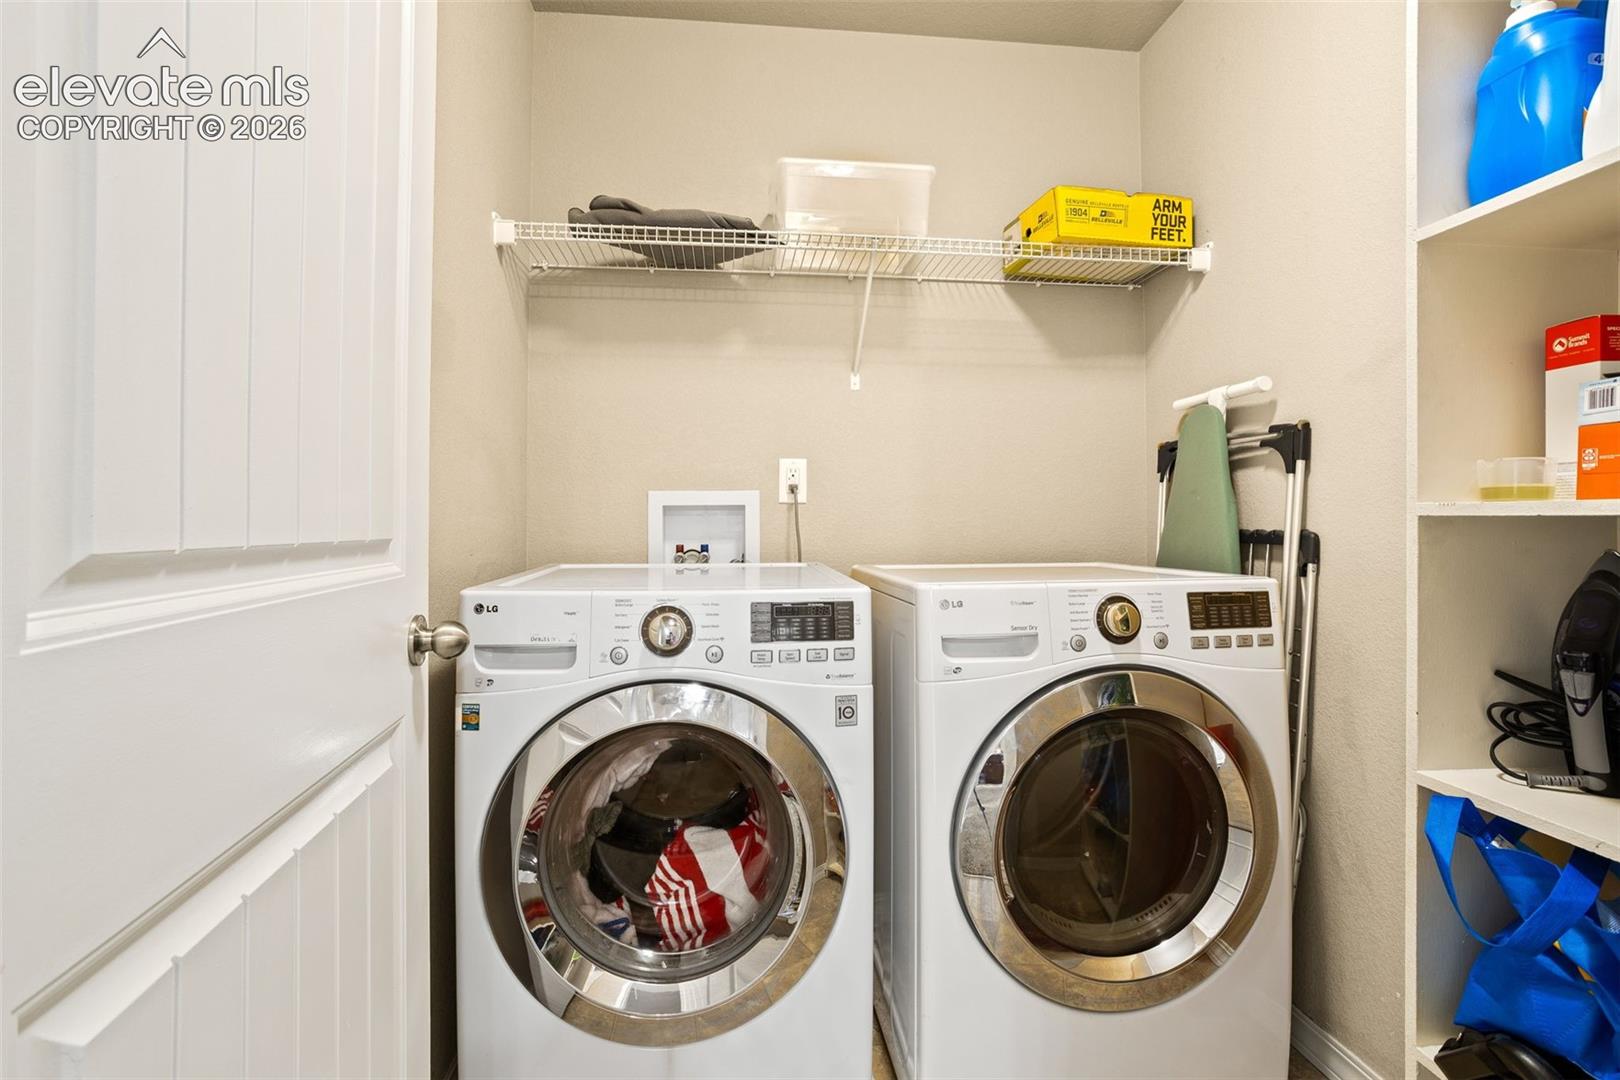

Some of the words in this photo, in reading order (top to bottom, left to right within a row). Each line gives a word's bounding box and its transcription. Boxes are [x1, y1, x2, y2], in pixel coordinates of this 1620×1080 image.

[1069, 207, 1088, 218] 1904
[1152, 198, 1183, 214] ARM
[1152, 213, 1187, 229] YOUR
[1151, 227, 1187, 243] FEET.
[487, 605, 498, 613] LG
[951, 600, 963, 609] LG
